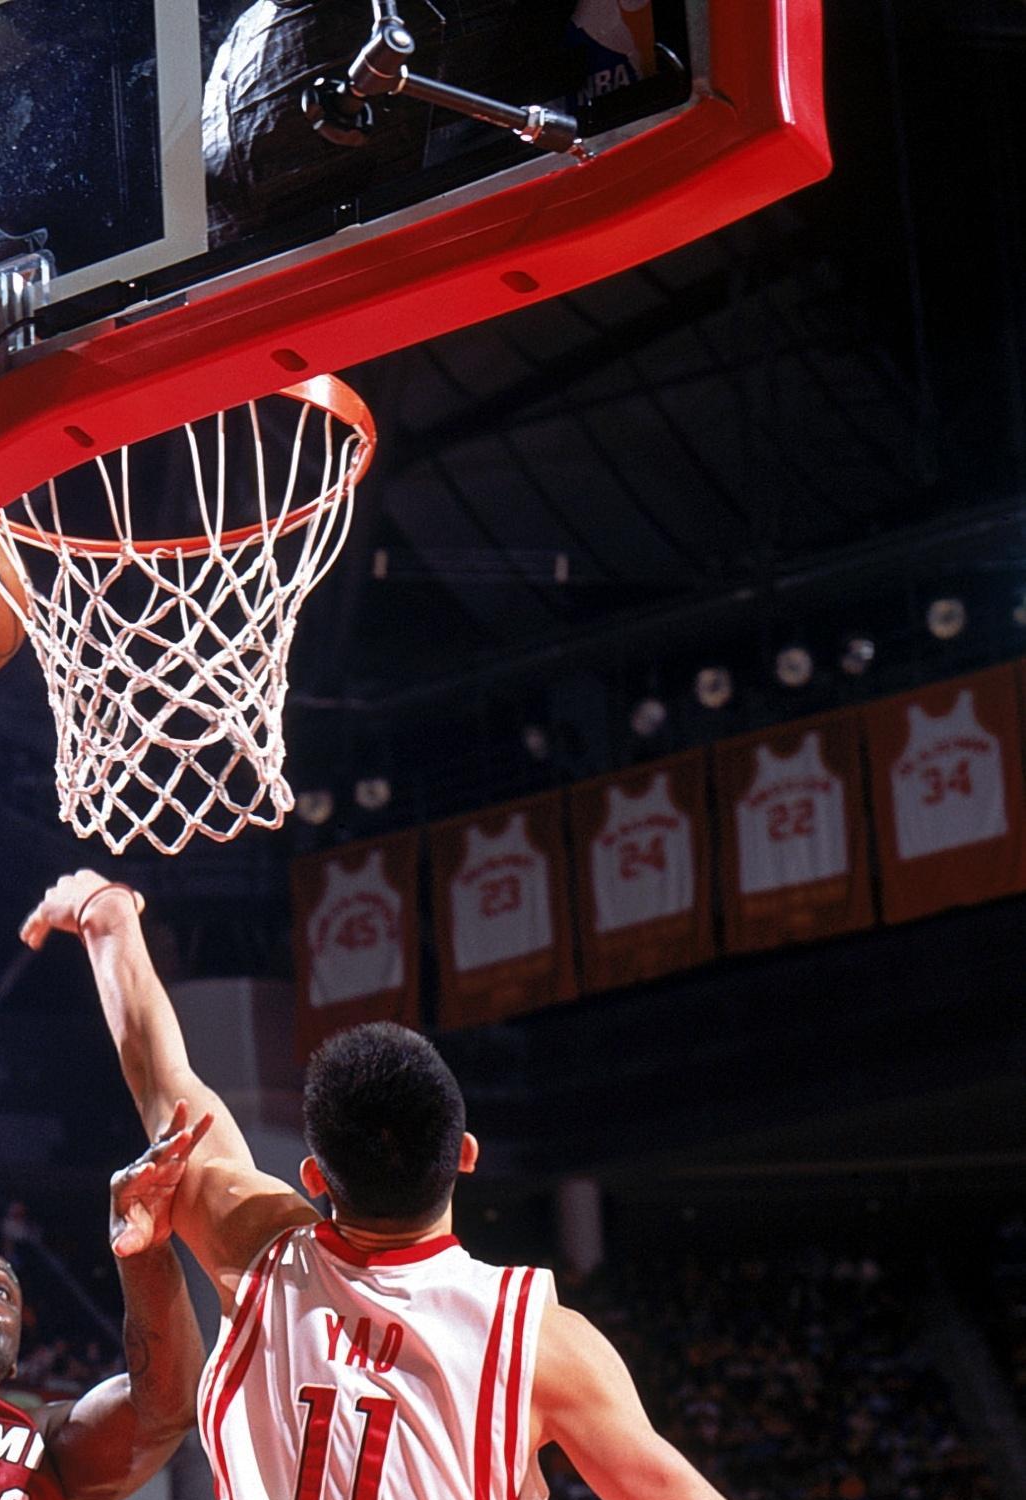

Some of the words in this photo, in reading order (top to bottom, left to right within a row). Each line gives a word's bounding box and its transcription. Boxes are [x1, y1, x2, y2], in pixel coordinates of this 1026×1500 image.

[921, 758, 973, 807] 34
[766, 794, 816, 842] 22
[324, 1313, 404, 1374] YAO
